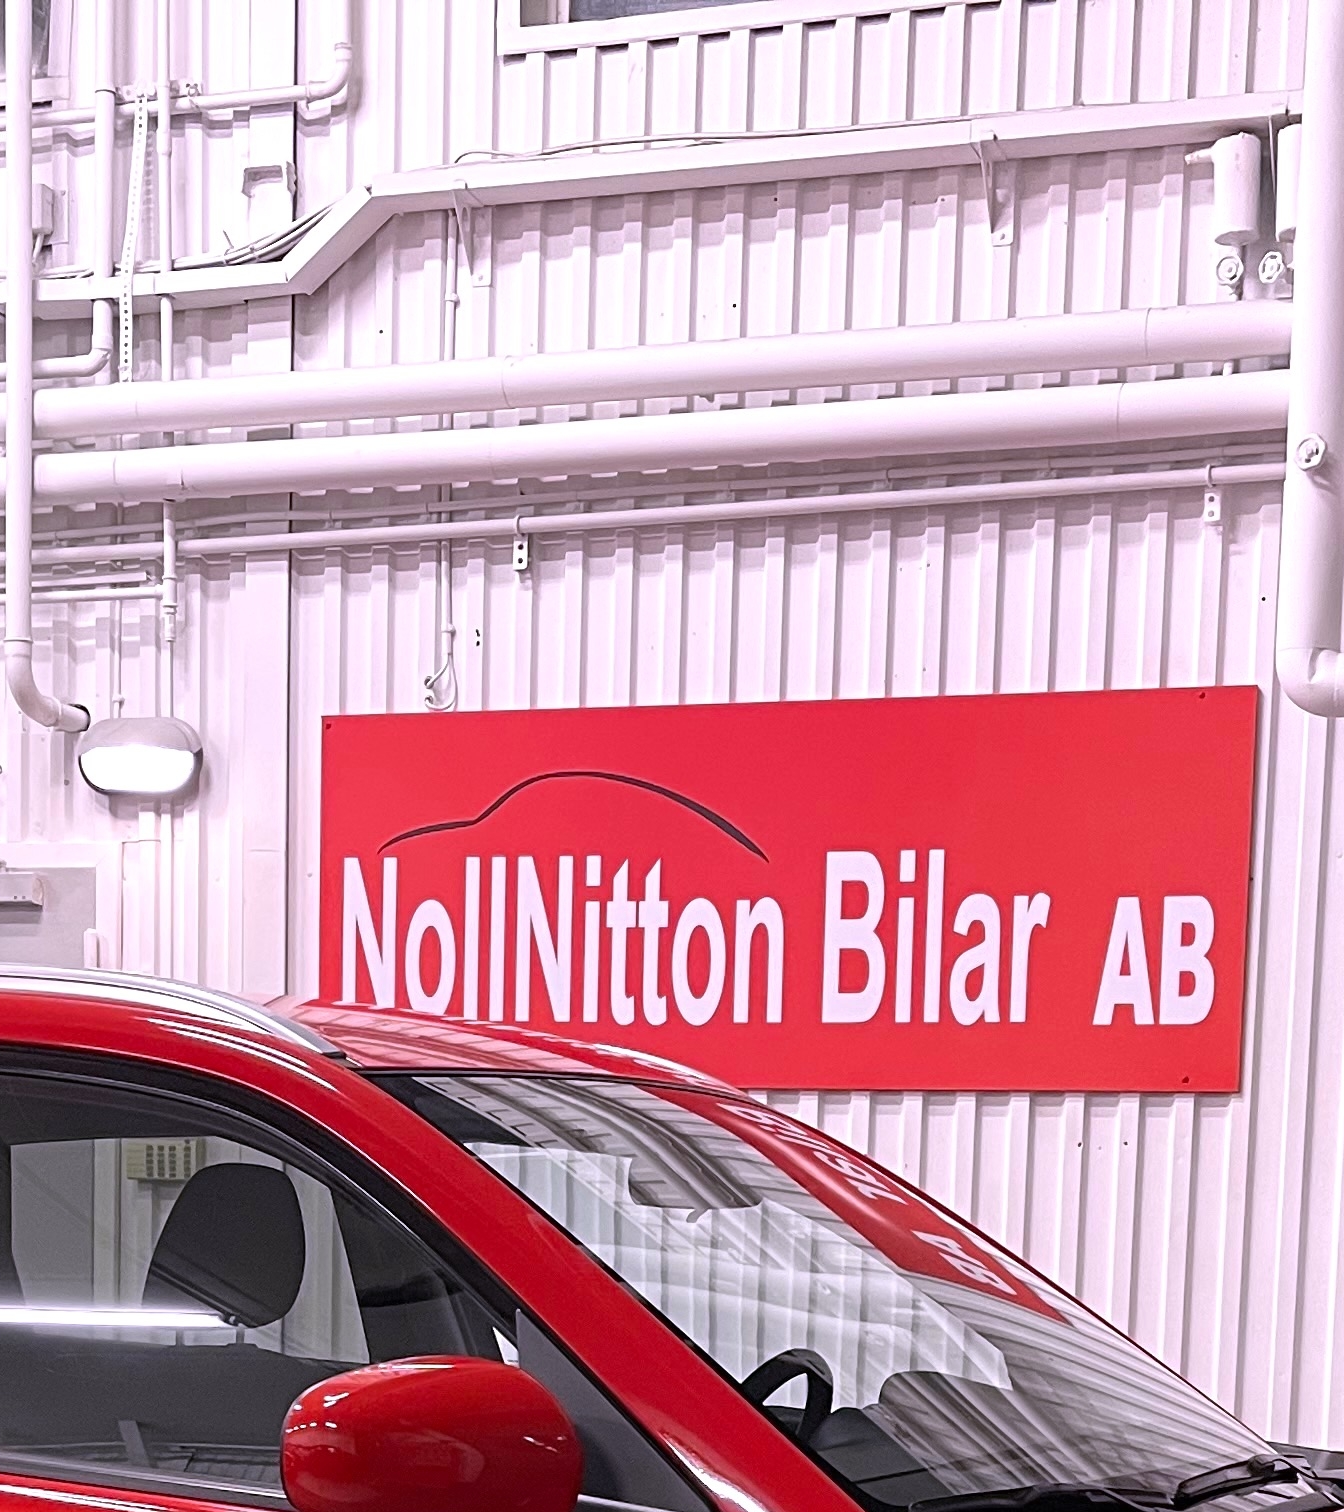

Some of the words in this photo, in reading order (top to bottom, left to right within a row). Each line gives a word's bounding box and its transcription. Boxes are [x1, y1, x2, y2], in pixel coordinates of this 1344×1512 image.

[342, 852, 785, 1027] NollNitton
[822, 849, 1051, 1026] Bilar
[1092, 894, 1217, 1027] AB
